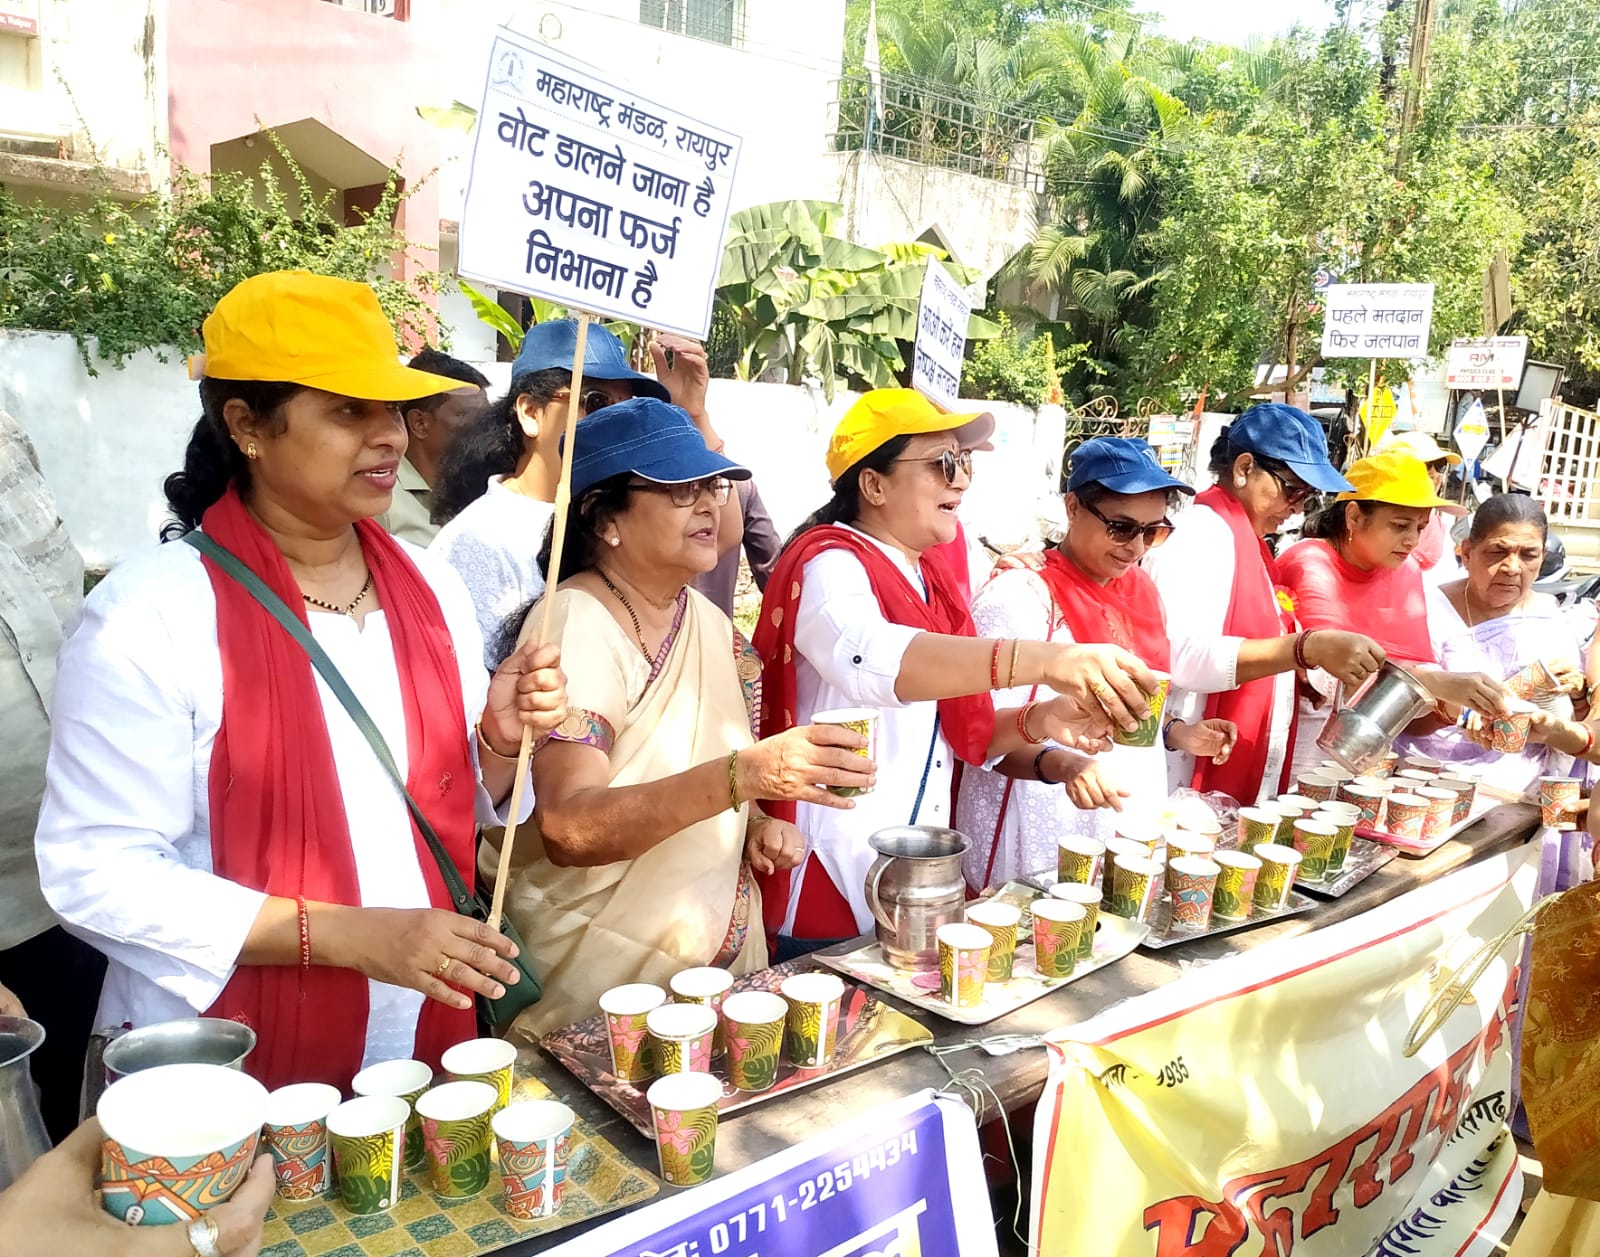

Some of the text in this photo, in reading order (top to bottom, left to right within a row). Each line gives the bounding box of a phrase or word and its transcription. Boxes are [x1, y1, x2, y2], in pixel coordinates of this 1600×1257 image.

[536, 69, 614, 128] महाराष्ट्र
[674, 126, 733, 170] रायपुर
[497, 107, 715, 217] वोट डालने जाना है
[522, 180, 682, 259] अपना फर्ज
[525, 229, 658, 309] निभाना है
[1329, 329, 1421, 349] फिर जलपान
[1332, 304, 1424, 325] पहले मतदान
[709, 1129, 918, 1255] 0771-2254434
